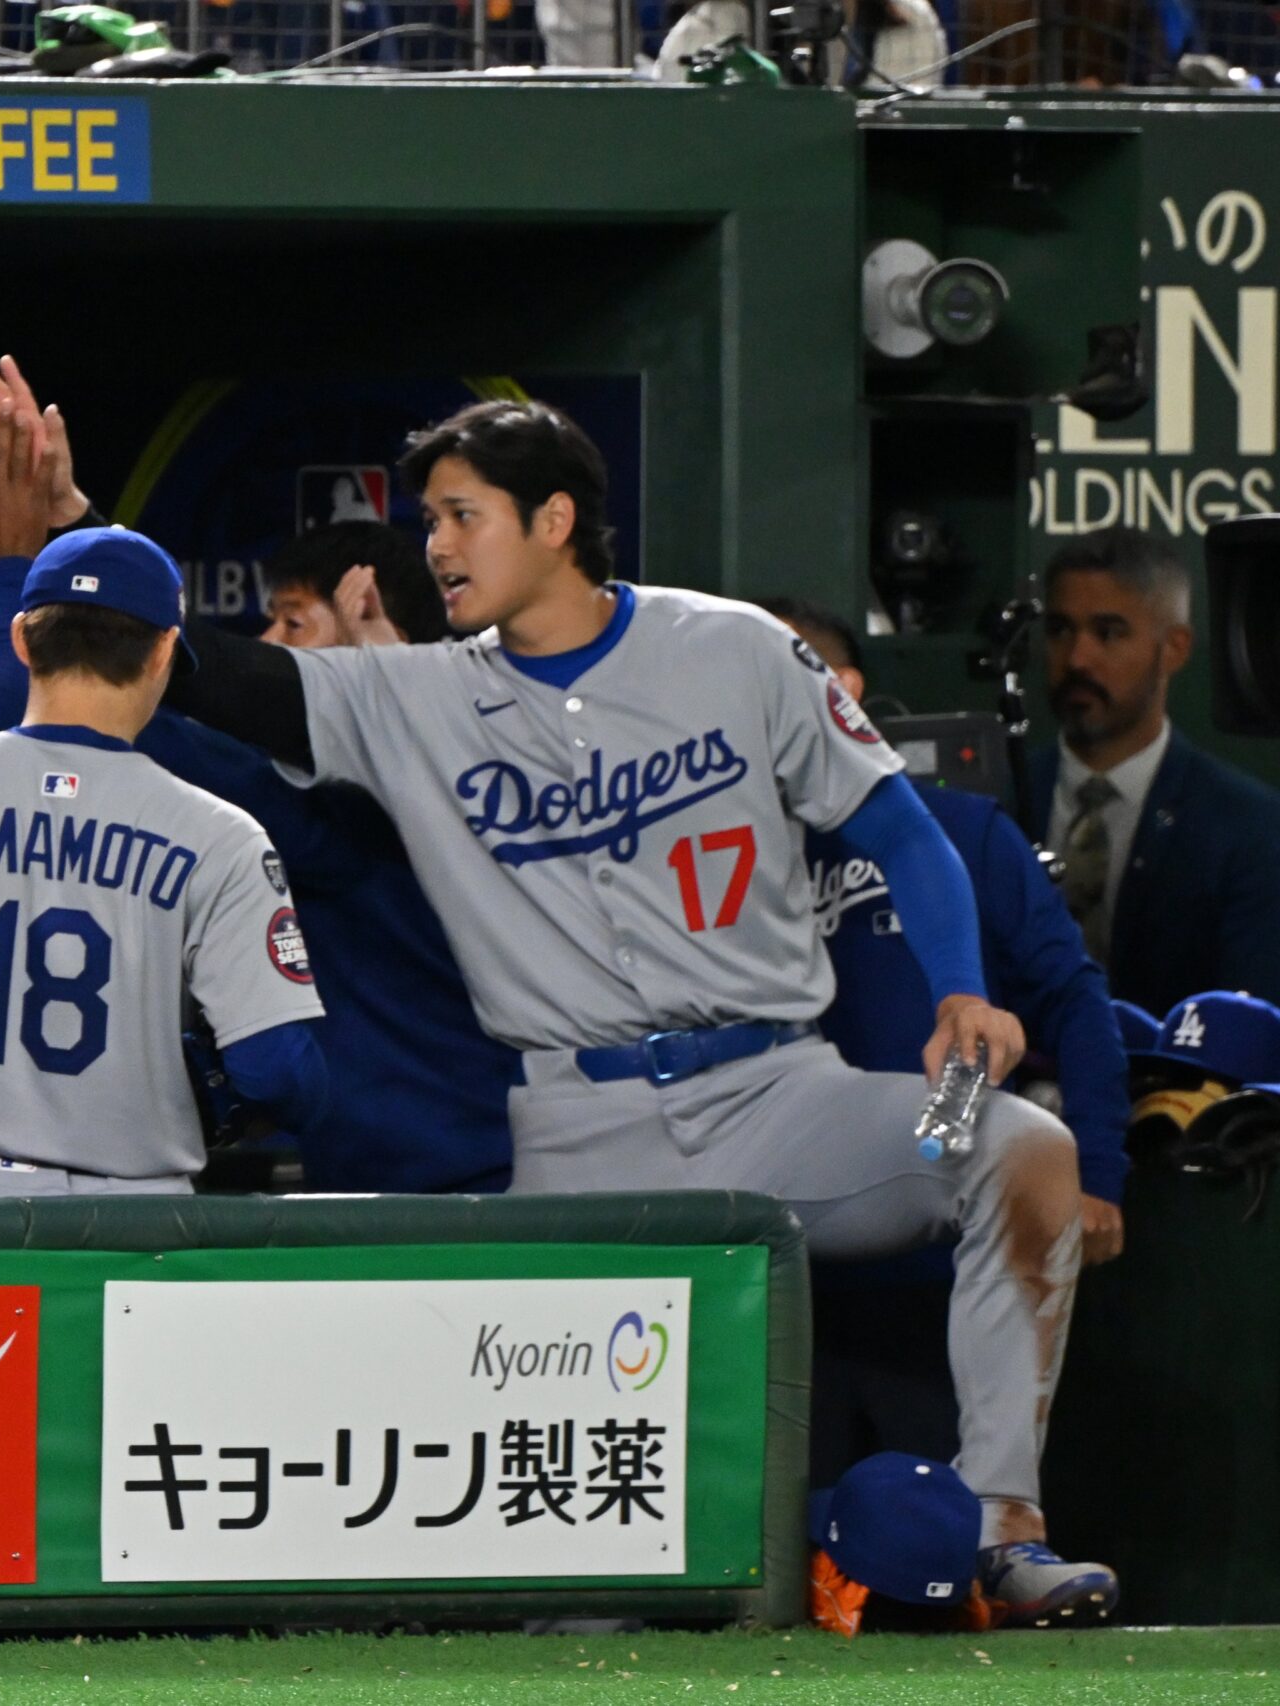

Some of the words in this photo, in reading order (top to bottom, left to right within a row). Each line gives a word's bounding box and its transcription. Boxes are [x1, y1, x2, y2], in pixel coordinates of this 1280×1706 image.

[456, 727, 750, 870] Dodgers
[667, 824, 759, 933] 17
[1173, 1002, 1206, 1048] LA
[470, 1322, 594, 1392] Kyorin
[123, 1418, 668, 1532] キョーリン製薬
